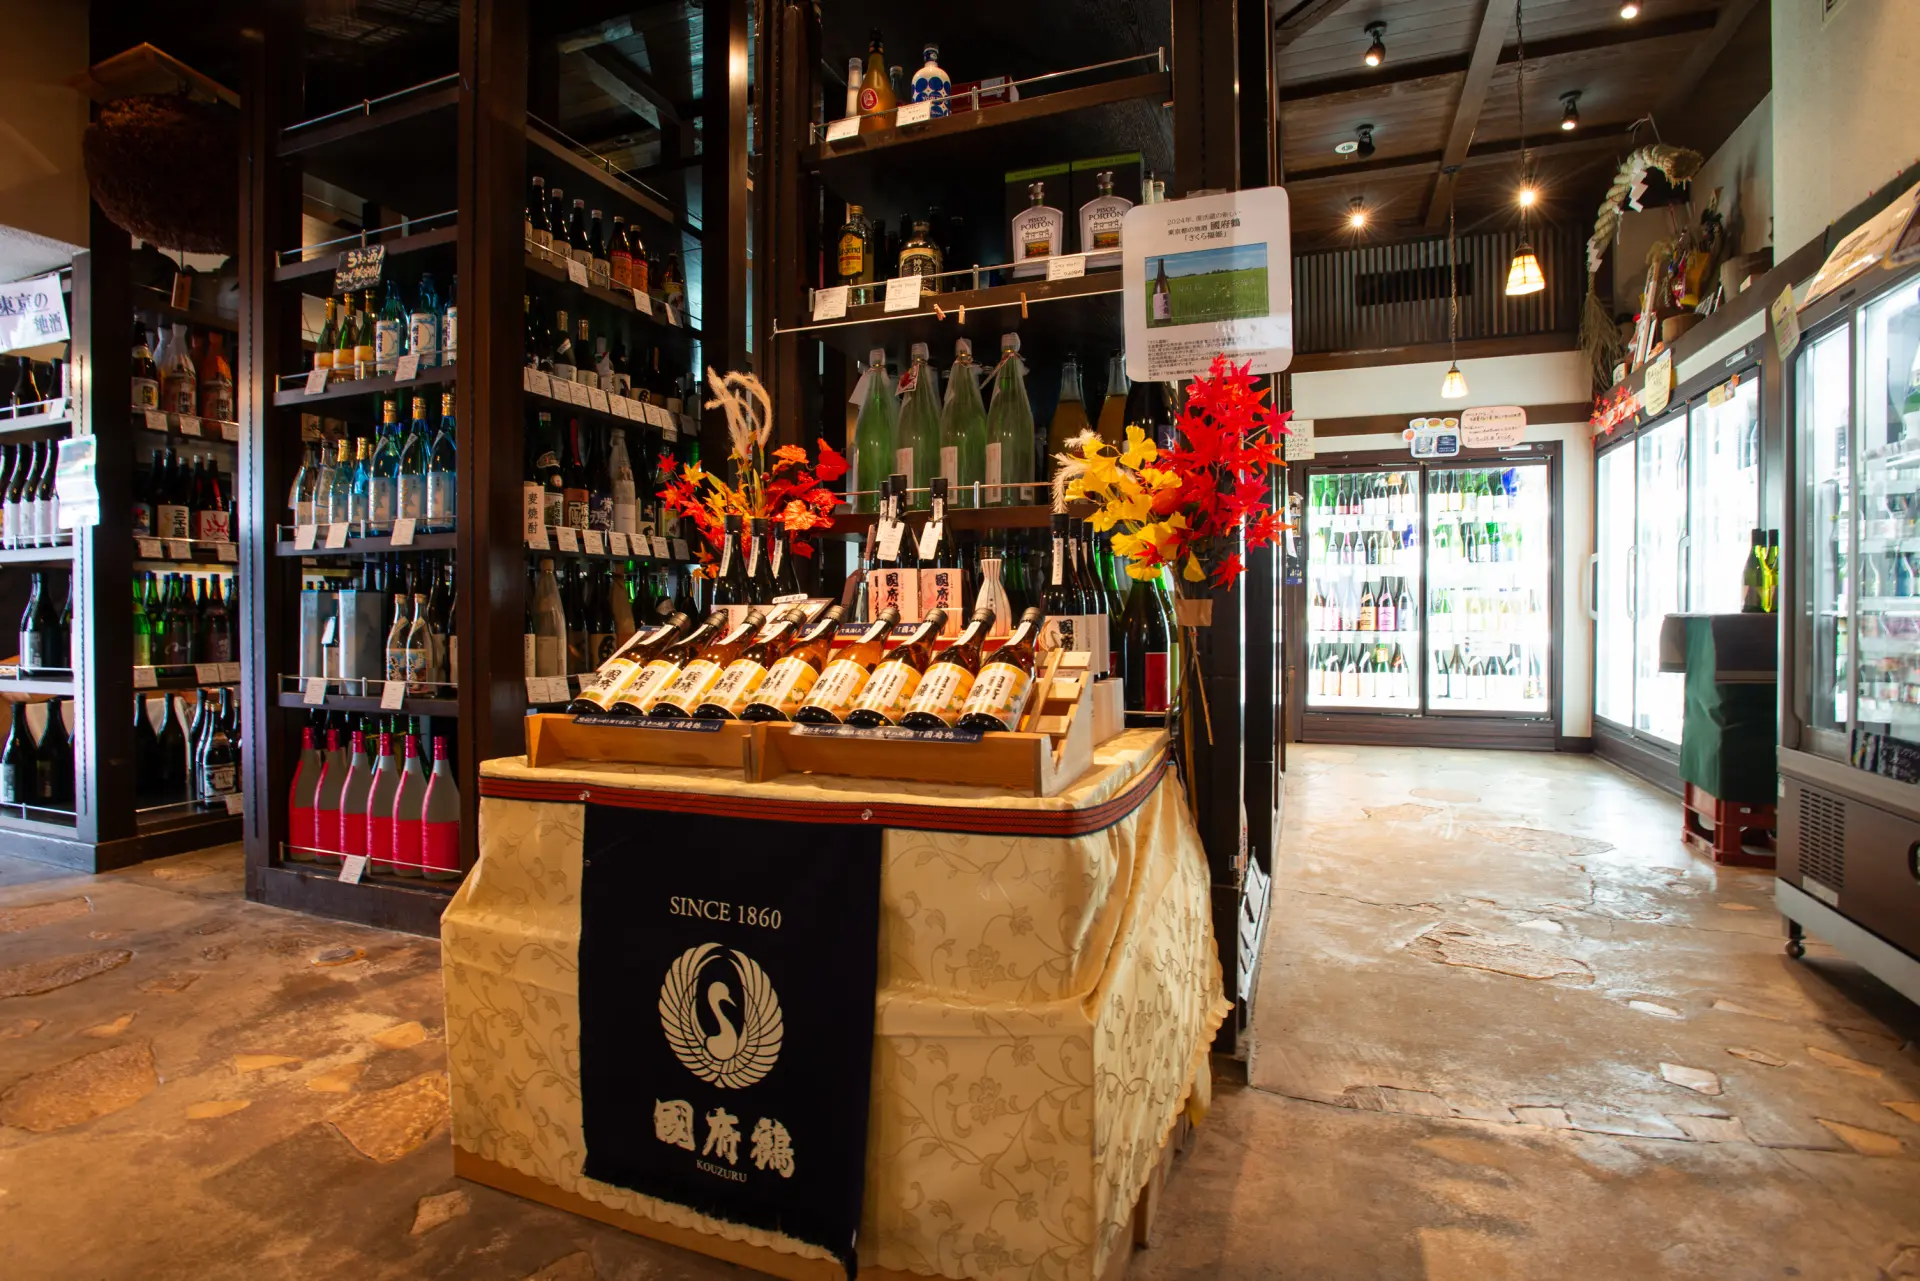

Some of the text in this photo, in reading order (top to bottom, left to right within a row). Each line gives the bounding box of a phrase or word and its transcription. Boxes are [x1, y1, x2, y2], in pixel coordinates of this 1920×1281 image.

[32, 311, 63, 335] 地酒
[527, 492, 539, 534] 麦焼酎
[669, 896, 782, 930] SINCE 1860
[653, 1097, 796, 1179] 國府鶴
[696, 1159, 748, 1183] KOUZURU
